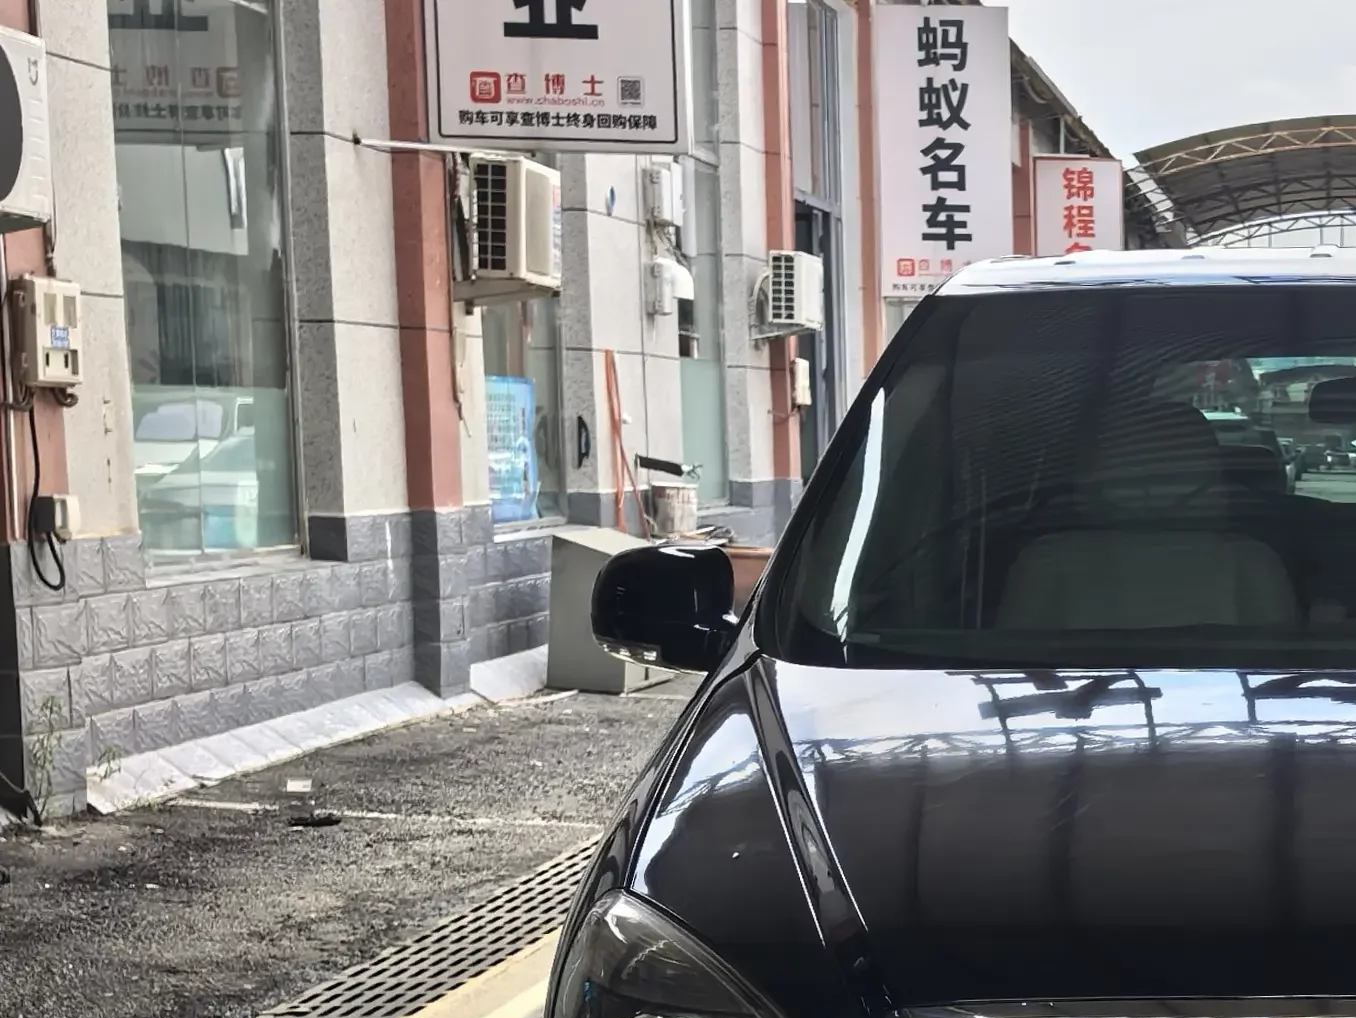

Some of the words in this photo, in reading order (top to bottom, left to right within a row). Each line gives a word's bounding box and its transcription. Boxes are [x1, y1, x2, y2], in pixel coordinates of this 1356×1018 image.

[506, 73, 604, 96] 查博士
[459, 110, 657, 129] 购车可享查博士终身回购保障
[917, 17, 972, 250] 蚂蚁名车
